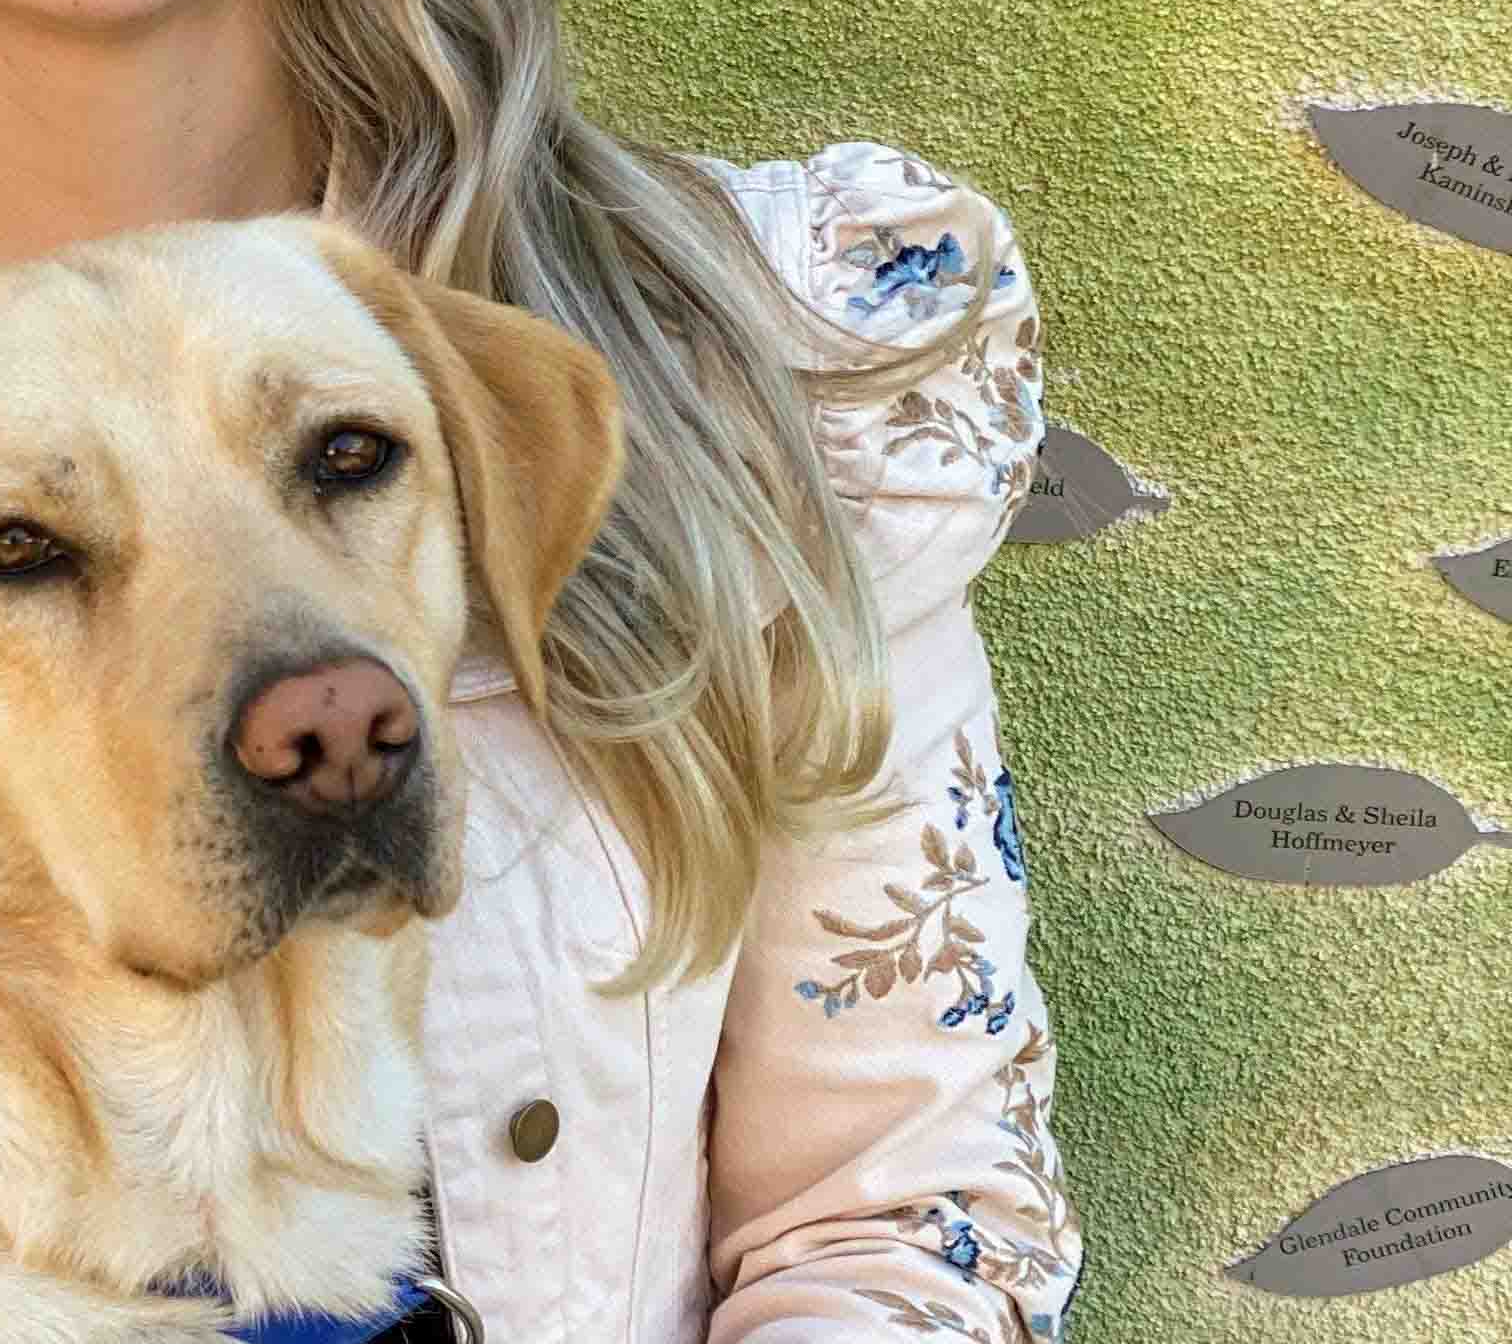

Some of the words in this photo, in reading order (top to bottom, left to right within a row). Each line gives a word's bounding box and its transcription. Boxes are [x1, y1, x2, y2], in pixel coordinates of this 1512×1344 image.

[1396, 121, 1478, 167] Joseph
[1481, 154, 1505, 177] &
[1231, 800, 1328, 826] Douglas
[1335, 805, 1356, 825] &
[1362, 805, 1438, 829] Sheila
[1271, 829, 1397, 858] Hoffmeyer
[1278, 1216, 1380, 1256] Glendale
[1341, 1221, 1473, 1268] Foundation
